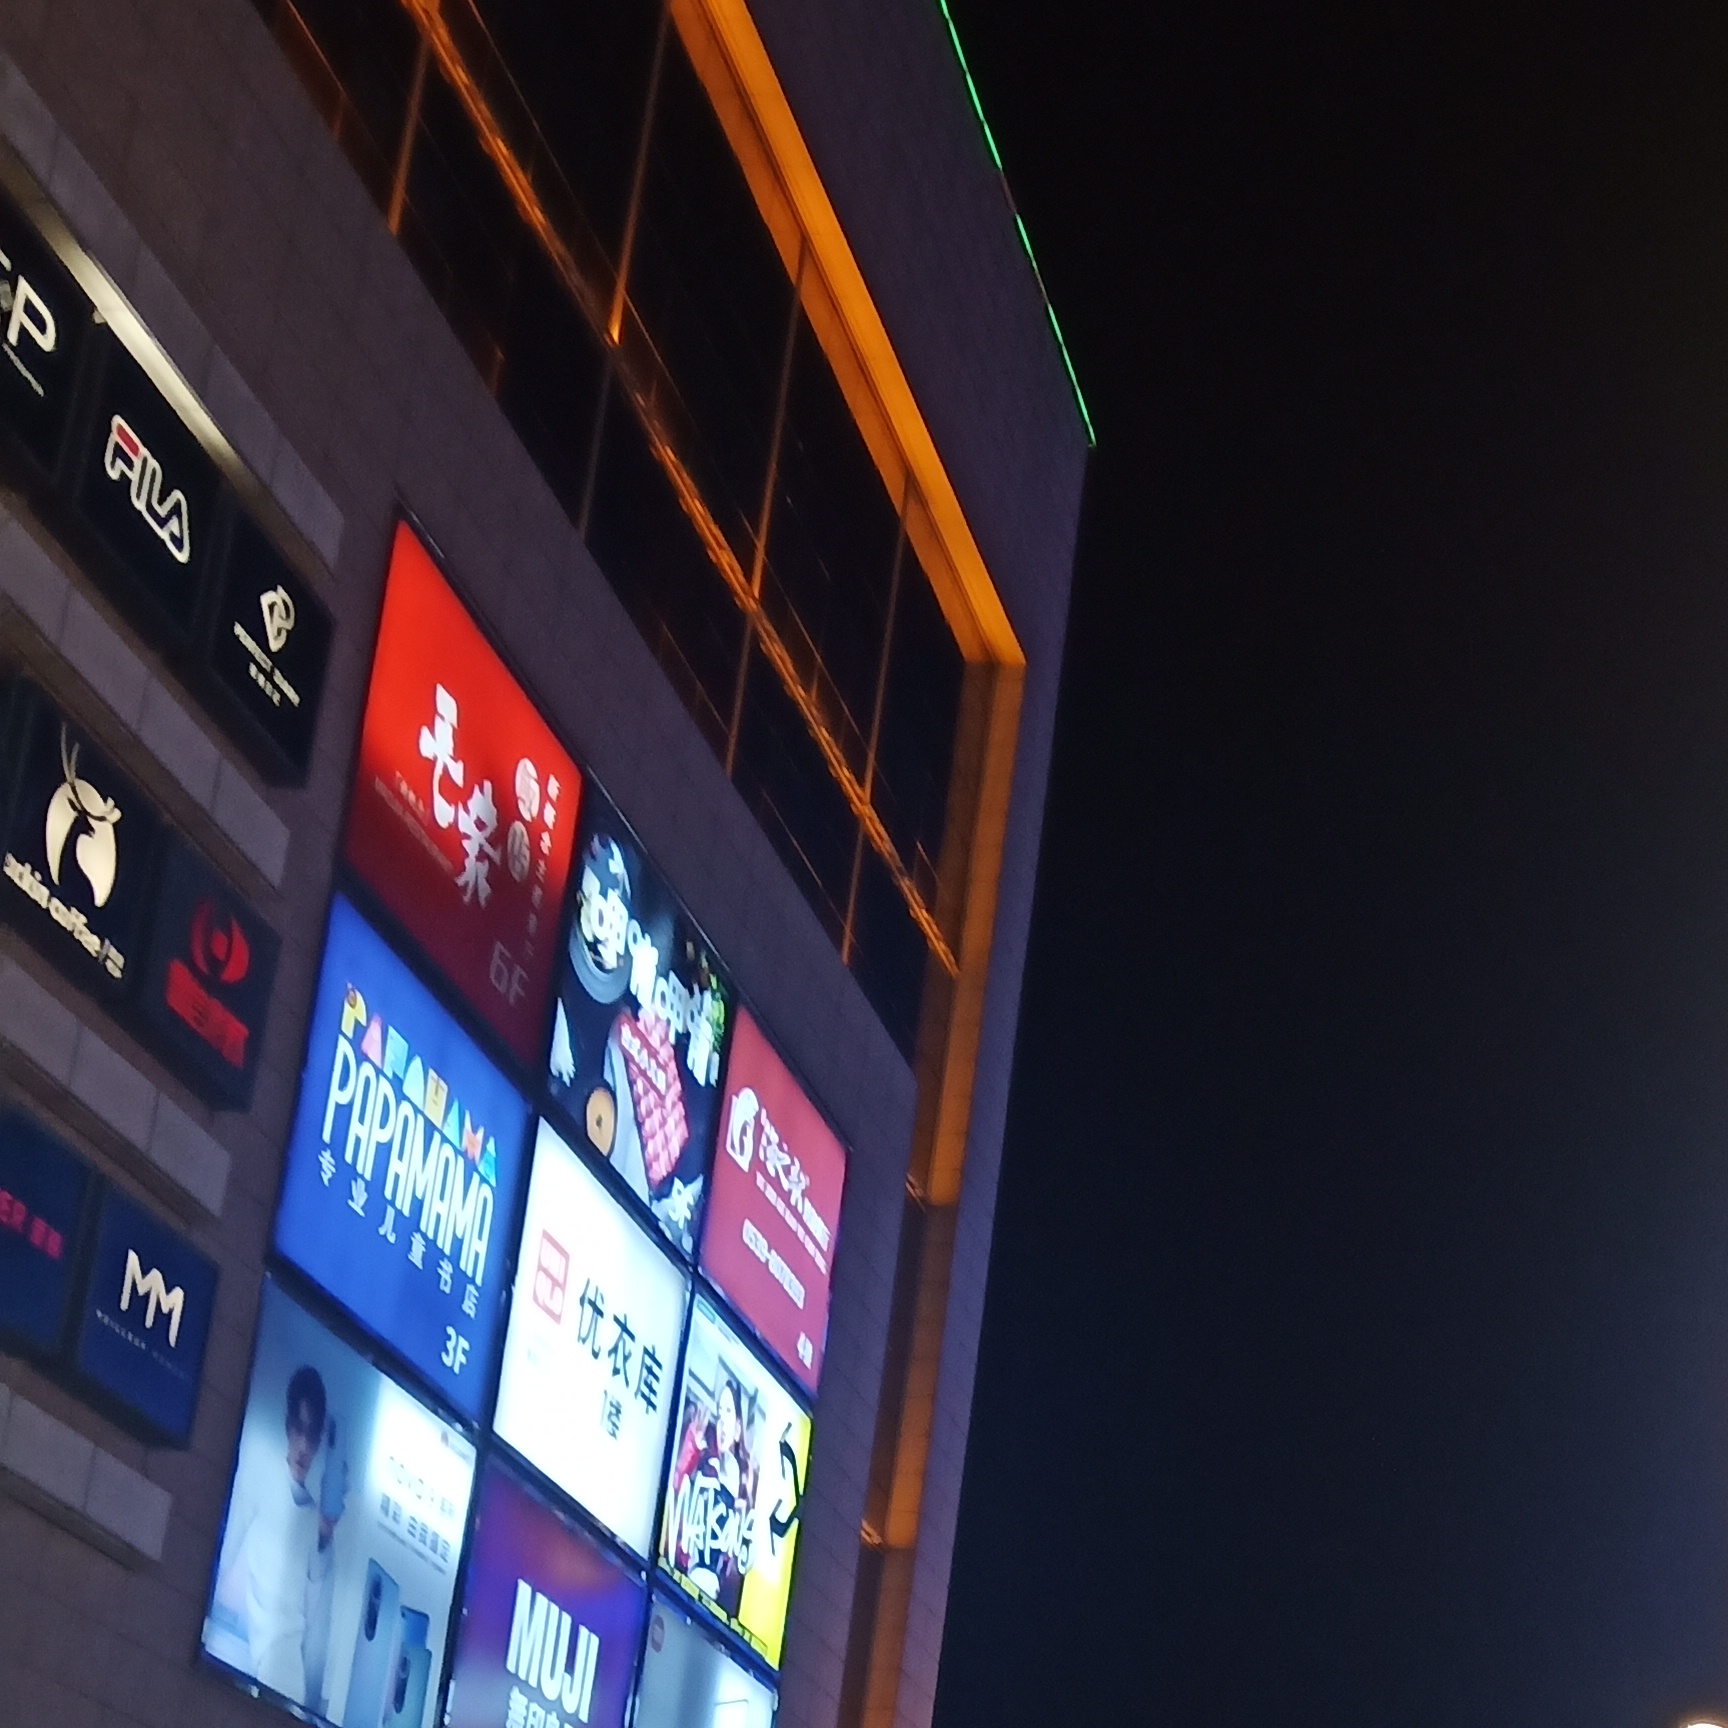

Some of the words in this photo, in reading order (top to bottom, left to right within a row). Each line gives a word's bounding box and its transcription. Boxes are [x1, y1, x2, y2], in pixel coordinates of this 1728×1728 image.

[105, 414, 190, 564] FILA
[317, 1149, 481, 1320] 专业儿童书店
[322, 1033, 494, 1288] PAPAMAMA
[441, 1326, 470, 1375] 3F
[577, 1277, 663, 1415] 优衣库
[506, 1578, 599, 1724] MUJI
